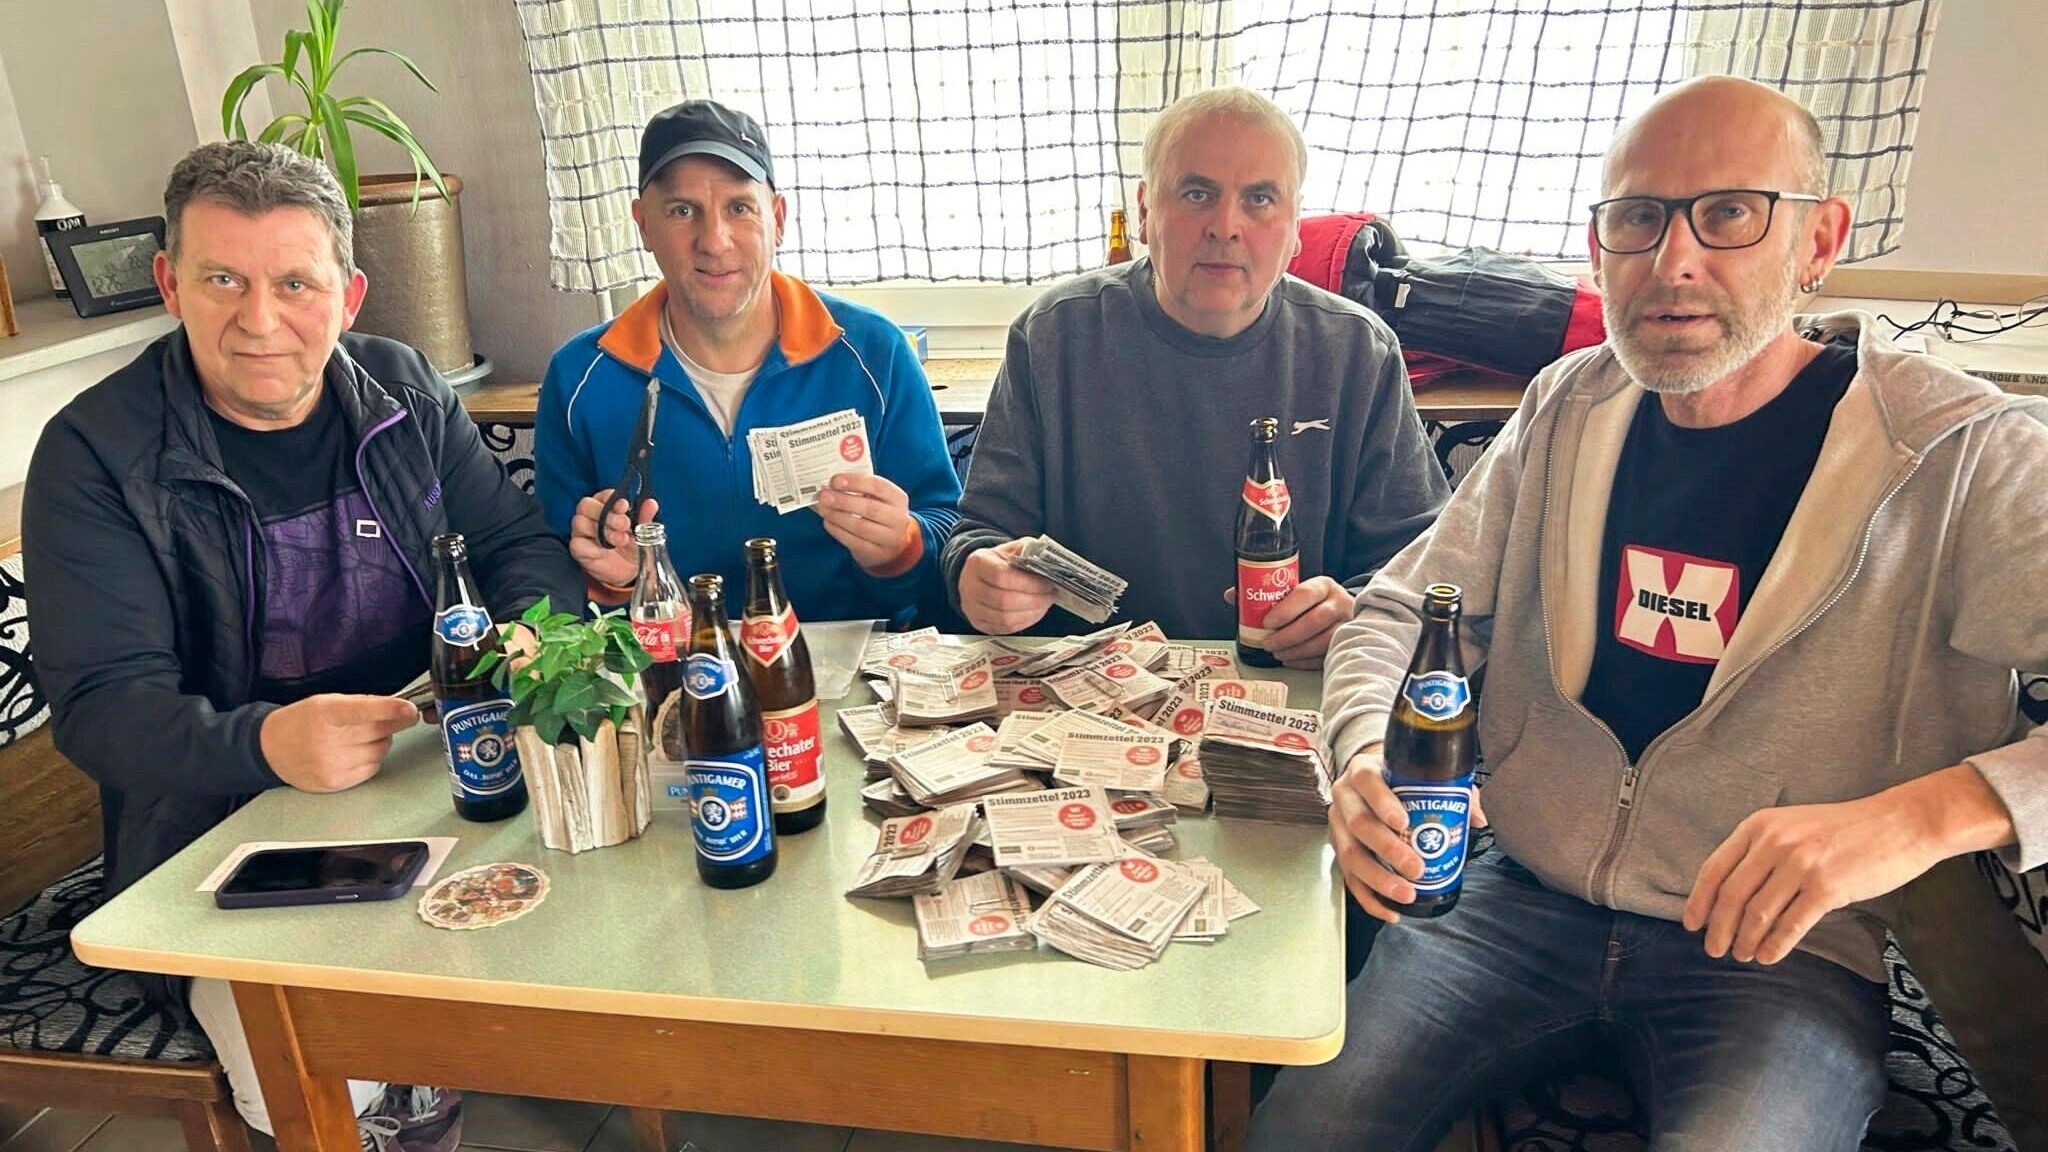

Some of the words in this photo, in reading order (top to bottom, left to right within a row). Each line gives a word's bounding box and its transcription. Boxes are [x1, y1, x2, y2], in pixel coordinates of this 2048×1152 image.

[789, 427, 840, 448] Stimmzettel
[842, 420, 861, 433] 2023
[1638, 589, 1711, 621] DIESEL
[1189, 666, 1213, 683] 2023
[1162, 696, 1183, 718] 2023
[1219, 699, 1287, 725] Stimmzettel
[1288, 718, 1318, 733] 2023
[451, 711, 508, 734] PUNTIGAME
[1068, 732, 1134, 742] Stimmzettel
[1136, 736, 1164, 744] 2023
[988, 793, 1060, 806] Stimmzettel
[1061, 789, 1091, 801] 2023
[1407, 799, 1467, 814] UNTIGAMER
[884, 824, 898, 847] 2023
